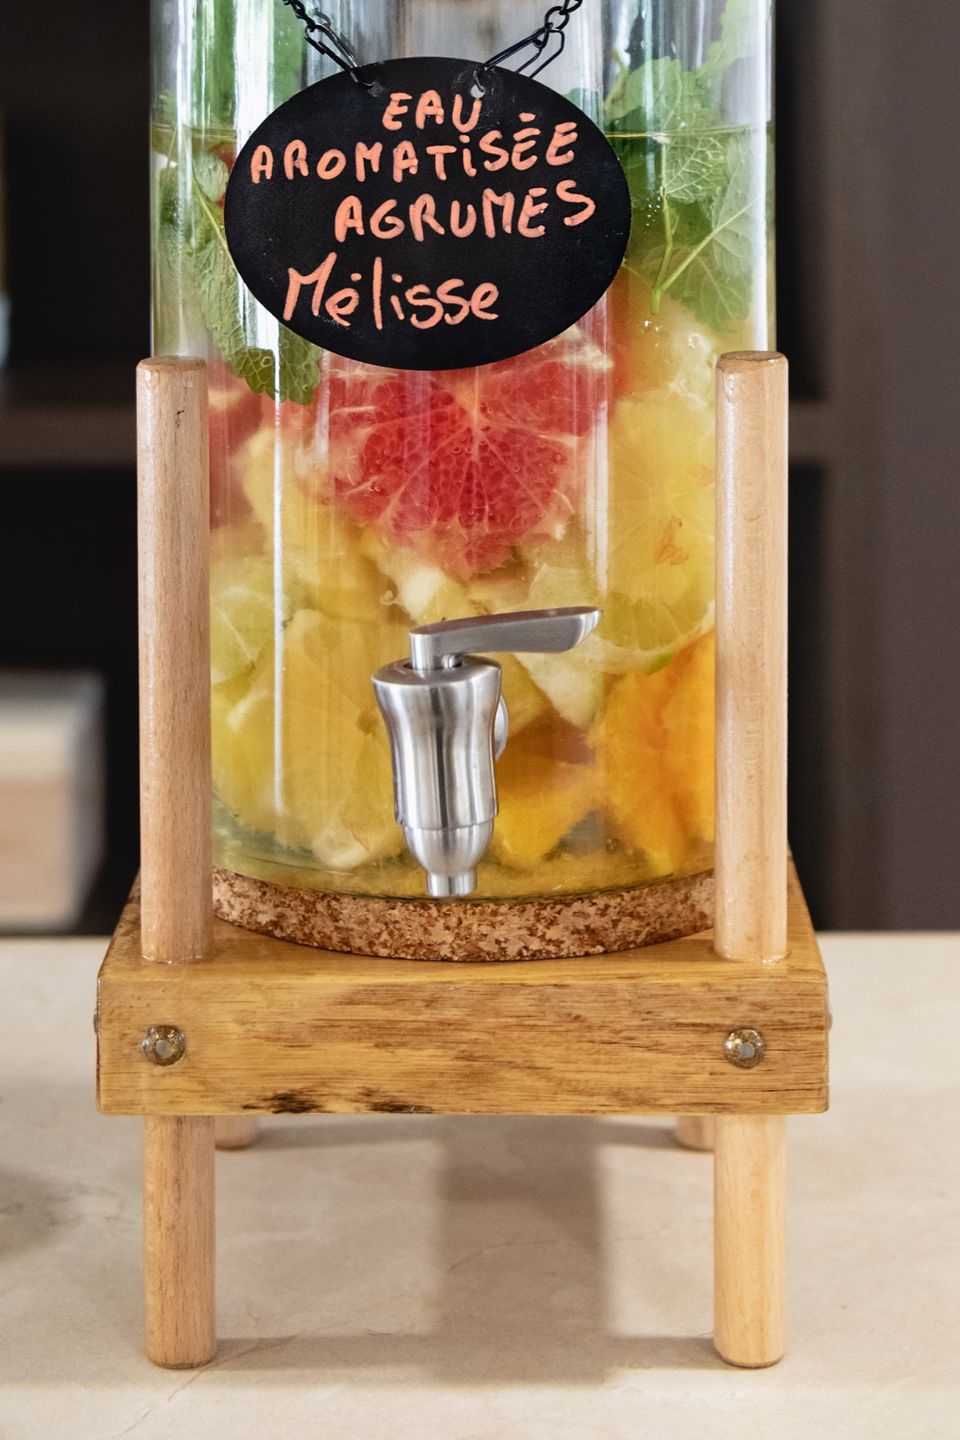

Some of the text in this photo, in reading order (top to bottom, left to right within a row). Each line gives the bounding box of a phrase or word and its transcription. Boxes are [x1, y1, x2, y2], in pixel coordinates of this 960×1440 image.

[382, 89, 482, 133] EAU
[334, 179, 596, 243] AGRUMES
[282, 251, 499, 330] Mélisse
